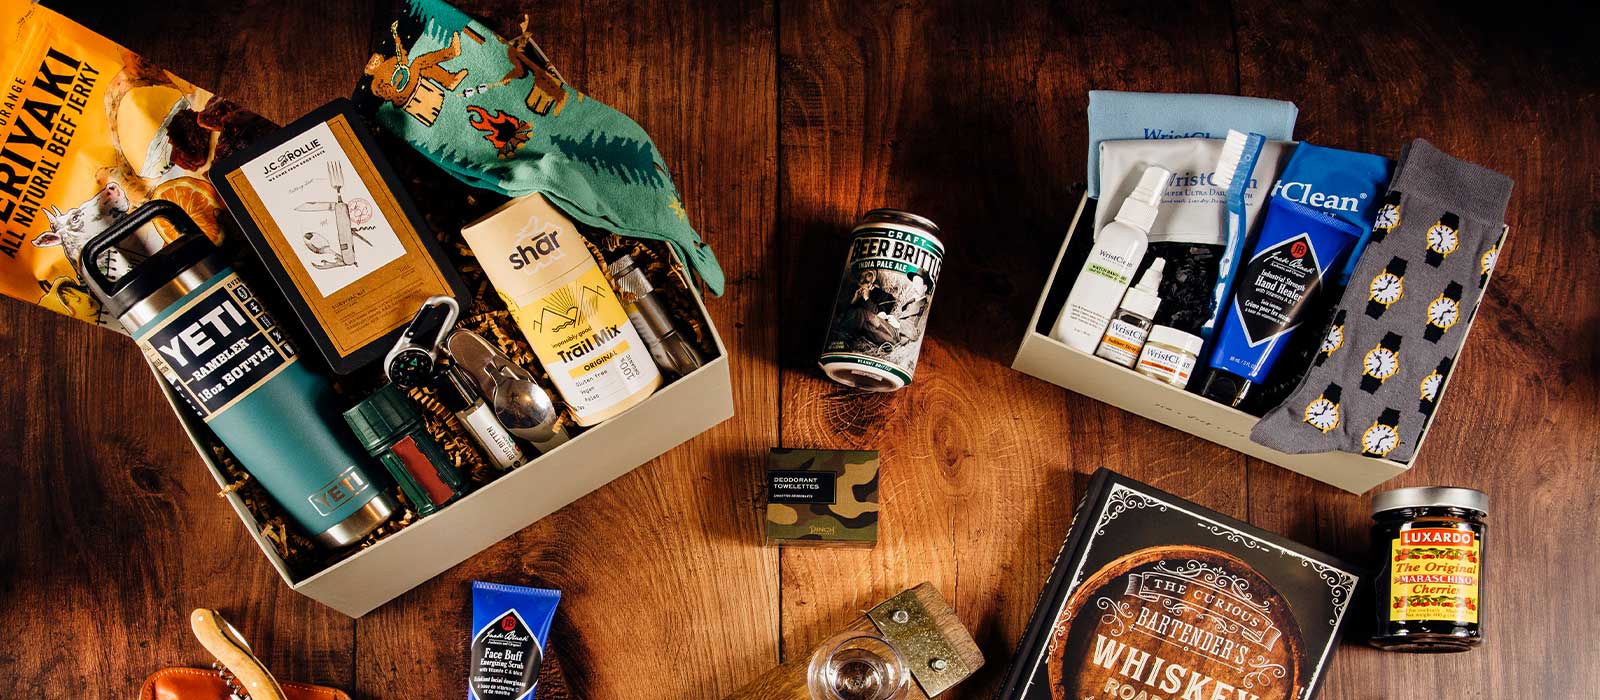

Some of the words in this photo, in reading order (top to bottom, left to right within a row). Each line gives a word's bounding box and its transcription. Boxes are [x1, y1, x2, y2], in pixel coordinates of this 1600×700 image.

[4, 230, 27, 259] ALL
[47, 114, 77, 158] BEEF
[66, 61, 100, 115] JERKY
[287, 138, 321, 161] ROLLIE
[1209, 188, 1227, 197] DAIL
[509, 229, 561, 270] shār
[888, 230, 927, 247] CRAFT
[858, 260, 875, 269] INDIA
[876, 260, 894, 269] PALE
[894, 263, 907, 272] ALE
[1254, 275, 1278, 291] Hand
[1277, 283, 1304, 302] Healer
[1261, 269, 1286, 283] Industrial
[1285, 278, 1306, 292] Strength
[158, 300, 247, 368] YETI
[551, 333, 578, 349] impossibly
[592, 324, 621, 348] Mix
[192, 337, 250, 382] RAMBLER
[583, 350, 618, 372] ORIGINAL
[197, 381, 226, 403] 18oz
[222, 344, 275, 386] BOTTLE
[486, 426, 506, 449] BITTEN
[502, 446, 515, 461] BUG
[314, 471, 364, 508] YETI
[1403, 532, 1471, 544] LUXARDO
[1396, 563, 1420, 573] The
[1425, 561, 1477, 575] Original
[1400, 574, 1473, 585] MARASCHINO
[1154, 579, 1187, 595] THE
[1193, 589, 1261, 629] CURIOUS
[1136, 606, 1249, 666] BARTENDER'S
[480, 658, 508, 669] Energizing
[508, 660, 524, 670] Scrub
[484, 647, 503, 660] Face
[504, 649, 524, 661] Buff
